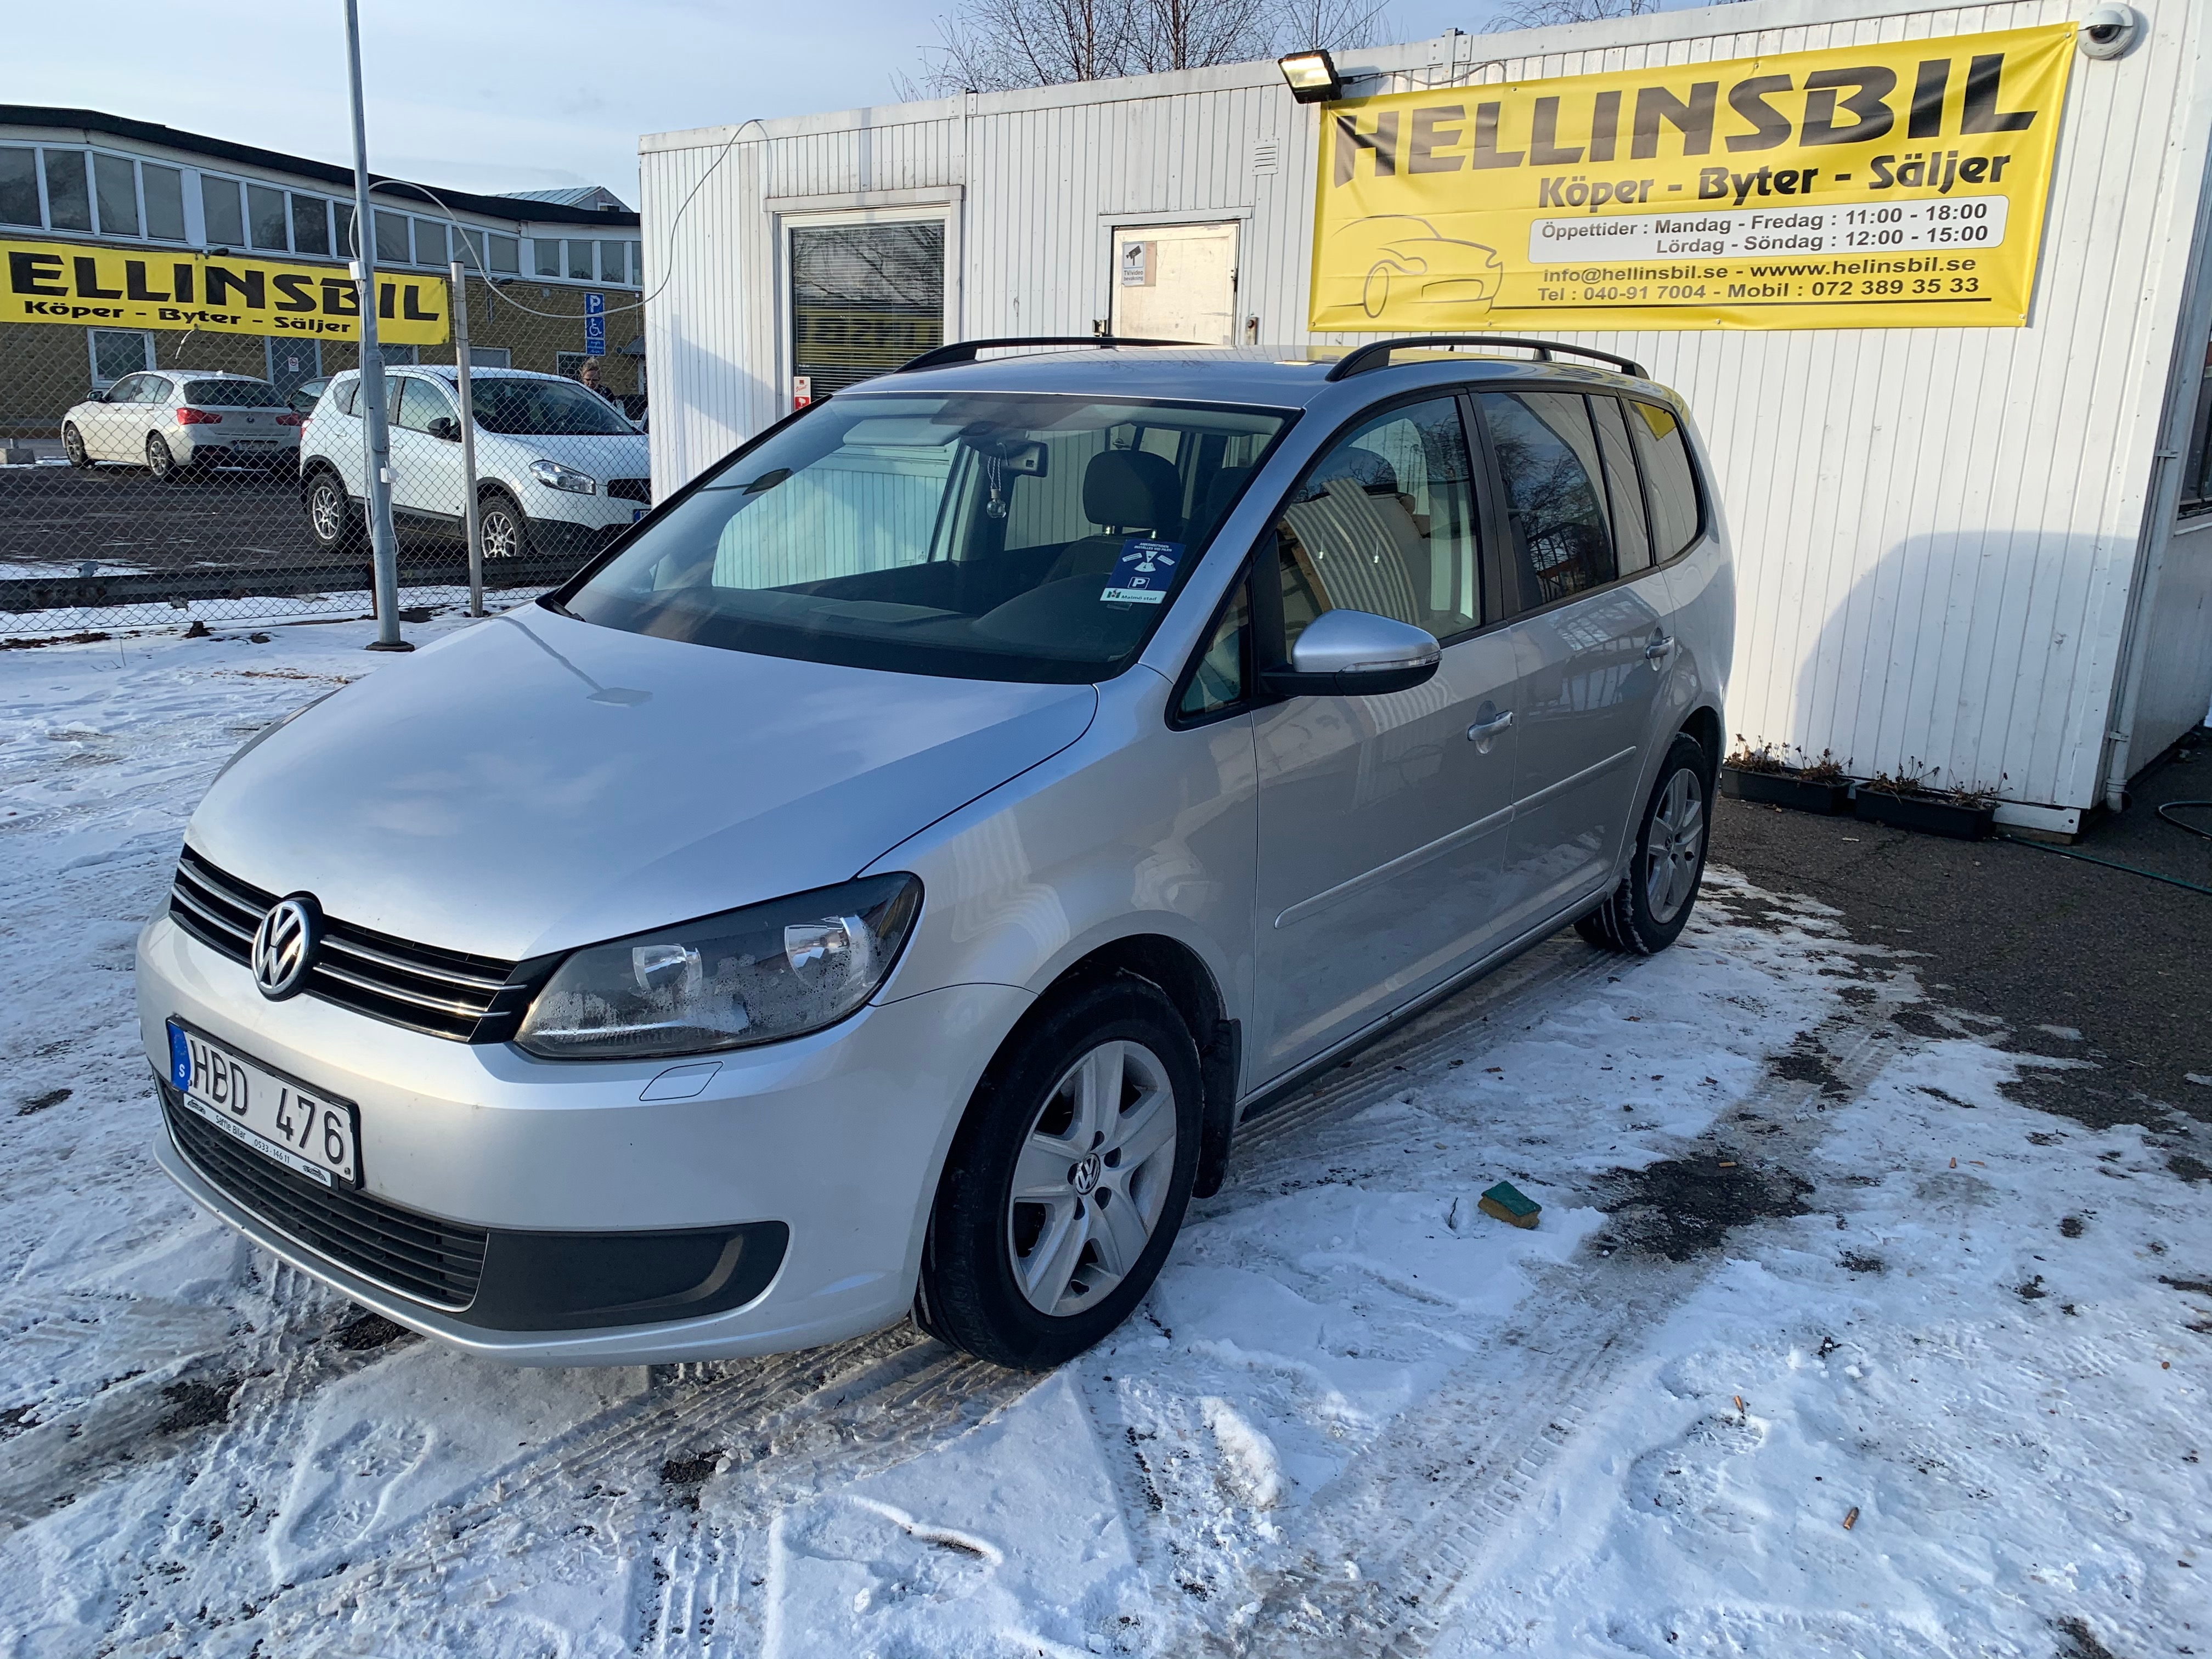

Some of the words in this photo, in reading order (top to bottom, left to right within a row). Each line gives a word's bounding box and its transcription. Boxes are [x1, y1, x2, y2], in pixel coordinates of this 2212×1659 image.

[1334, 53, 2038, 188] HELLINSBIL
[1539, 175, 1654, 213] Köper
[1698, 165, 1819, 206] Byter
[1869, 150, 2011, 195] Säljer
[1542, 222, 1638, 240] Öppettider
[1655, 218, 1731, 234] Mandag
[1751, 213, 1824, 230] Fredag
[1846, 208, 1902, 225] 11:00
[1926, 203, 1987, 221] 18:00
[1656, 239, 1724, 255] Lördag
[1745, 234, 1824, 251] Söndag
[1846, 229, 1903, 246] 12:00
[1926, 225, 1988, 243] 15:00
[1544, 266, 1728, 284] info@hellinsbil.se
[1750, 257, 1976, 277] wwww.helinsbil.se
[590, 295, 601, 313] P
[1538, 287, 1564, 301] Tel
[1584, 286, 1648, 300] 040-91
[1657, 285, 1706, 299] 7004
[1728, 283, 1788, 298] Mobil
[1812, 281, 1853, 296] 072
[1861, 280, 1903, 295] 389
[1912, 279, 1942, 294] 35
[1949, 278, 1979, 292] 33
[25, 301, 124, 319] Köper
[158, 308, 241, 325] Byter
[274, 316, 351, 333] Säljer
[1132, 578, 1146, 586] P
[179, 1064, 185, 1078] S
[190, 1040, 249, 1116] HBD
[276, 1088, 345, 1165] 476
[233, 1125, 246, 1139] Bilar
[254, 1139, 269, 1152] 0533
[273, 1149, 283, 1160] 146
[284, 1155, 290, 1164] 11
